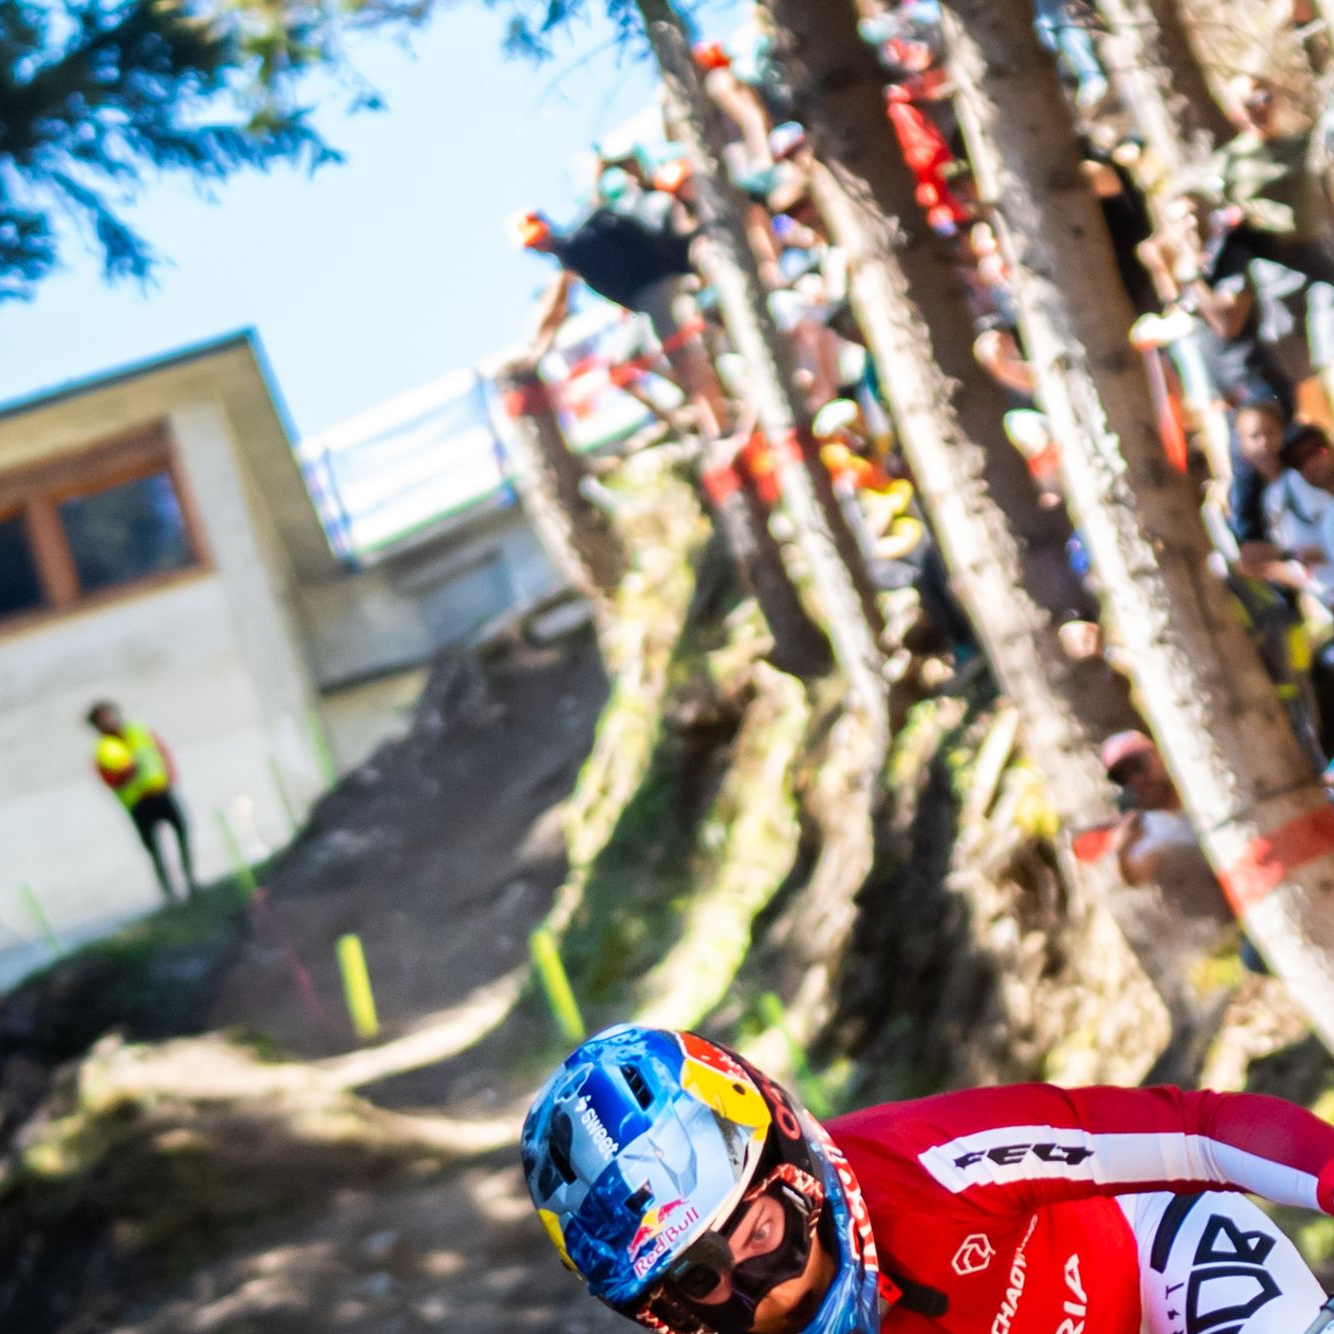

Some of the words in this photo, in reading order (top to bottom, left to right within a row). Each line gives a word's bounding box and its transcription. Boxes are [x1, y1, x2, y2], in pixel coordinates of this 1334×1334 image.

[581, 1108, 620, 1160] sweet
[633, 1237, 666, 1277] Red
[666, 1206, 700, 1244] Bull
